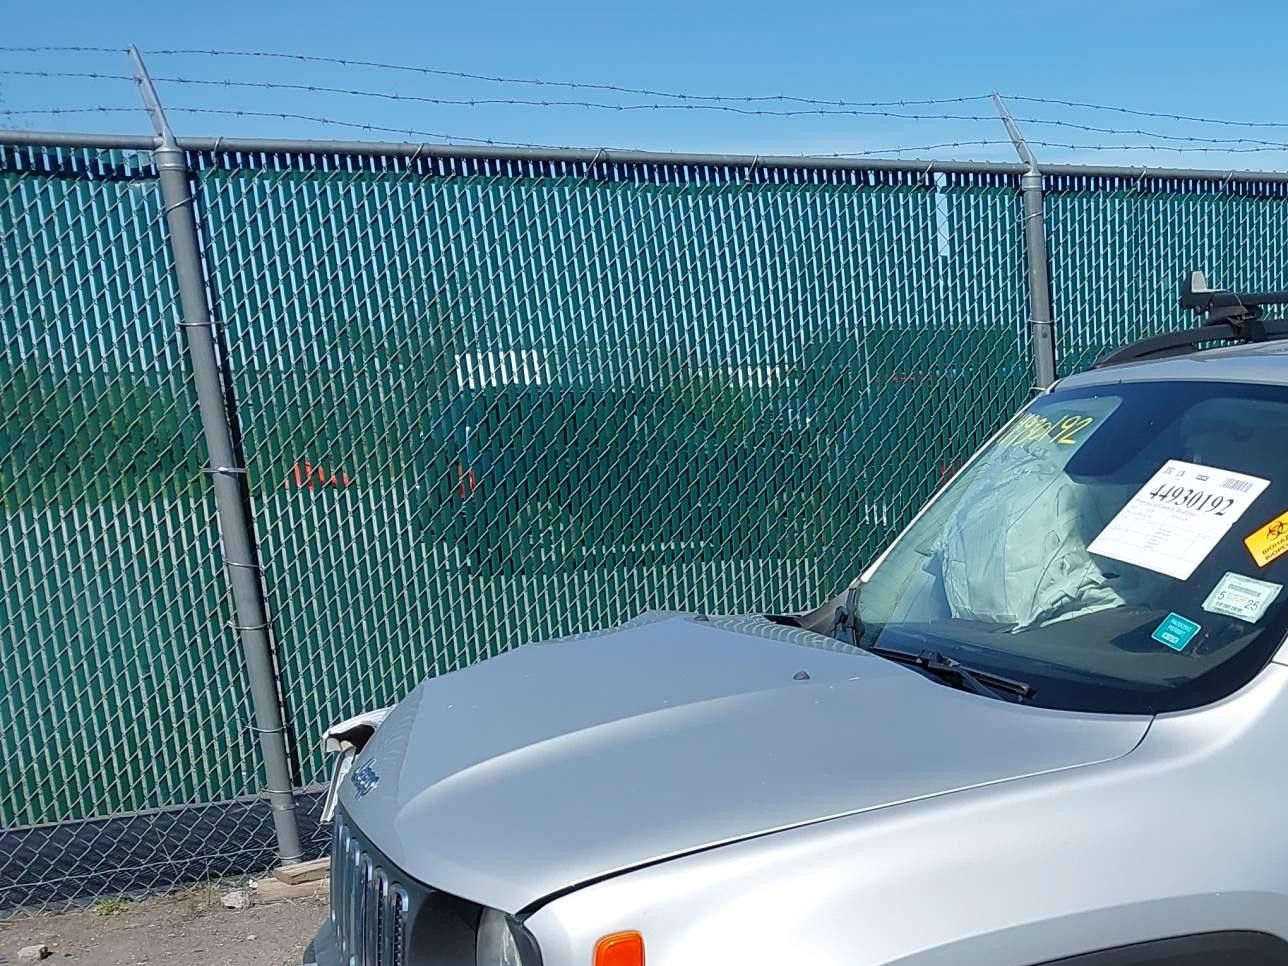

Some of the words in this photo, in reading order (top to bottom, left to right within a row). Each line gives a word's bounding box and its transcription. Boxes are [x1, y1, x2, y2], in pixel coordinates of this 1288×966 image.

[1149, 483, 1235, 516] 44930192
[1217, 590, 1227, 601] 5
[1244, 599, 1260, 611] 25
